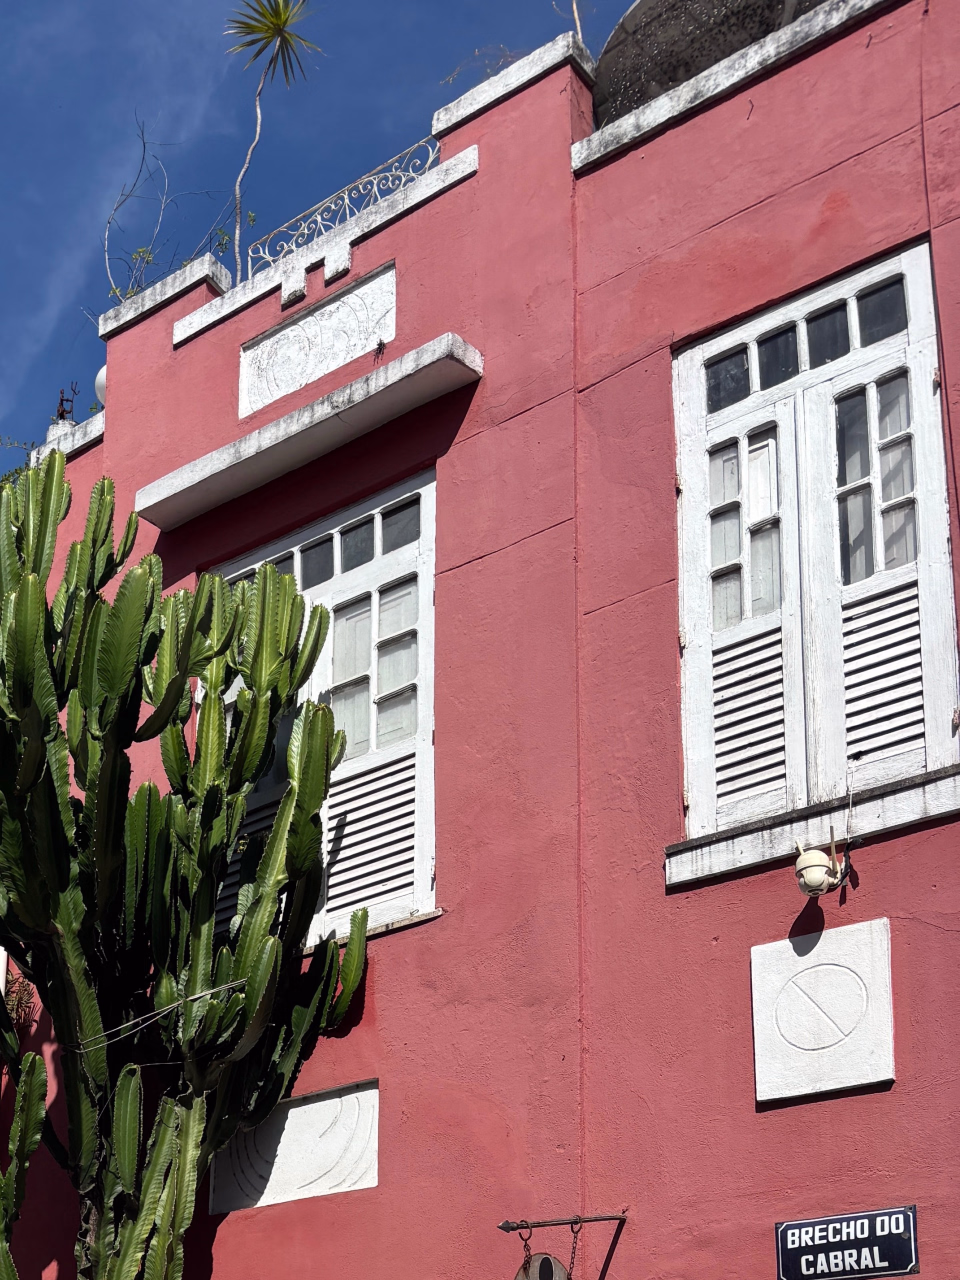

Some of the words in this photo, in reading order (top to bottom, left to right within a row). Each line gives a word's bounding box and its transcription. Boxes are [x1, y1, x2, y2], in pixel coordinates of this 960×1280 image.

[787, 1218, 869, 1249] BRECHO
[875, 1213, 904, 1237] DO
[800, 1245, 889, 1276] CABRAL
